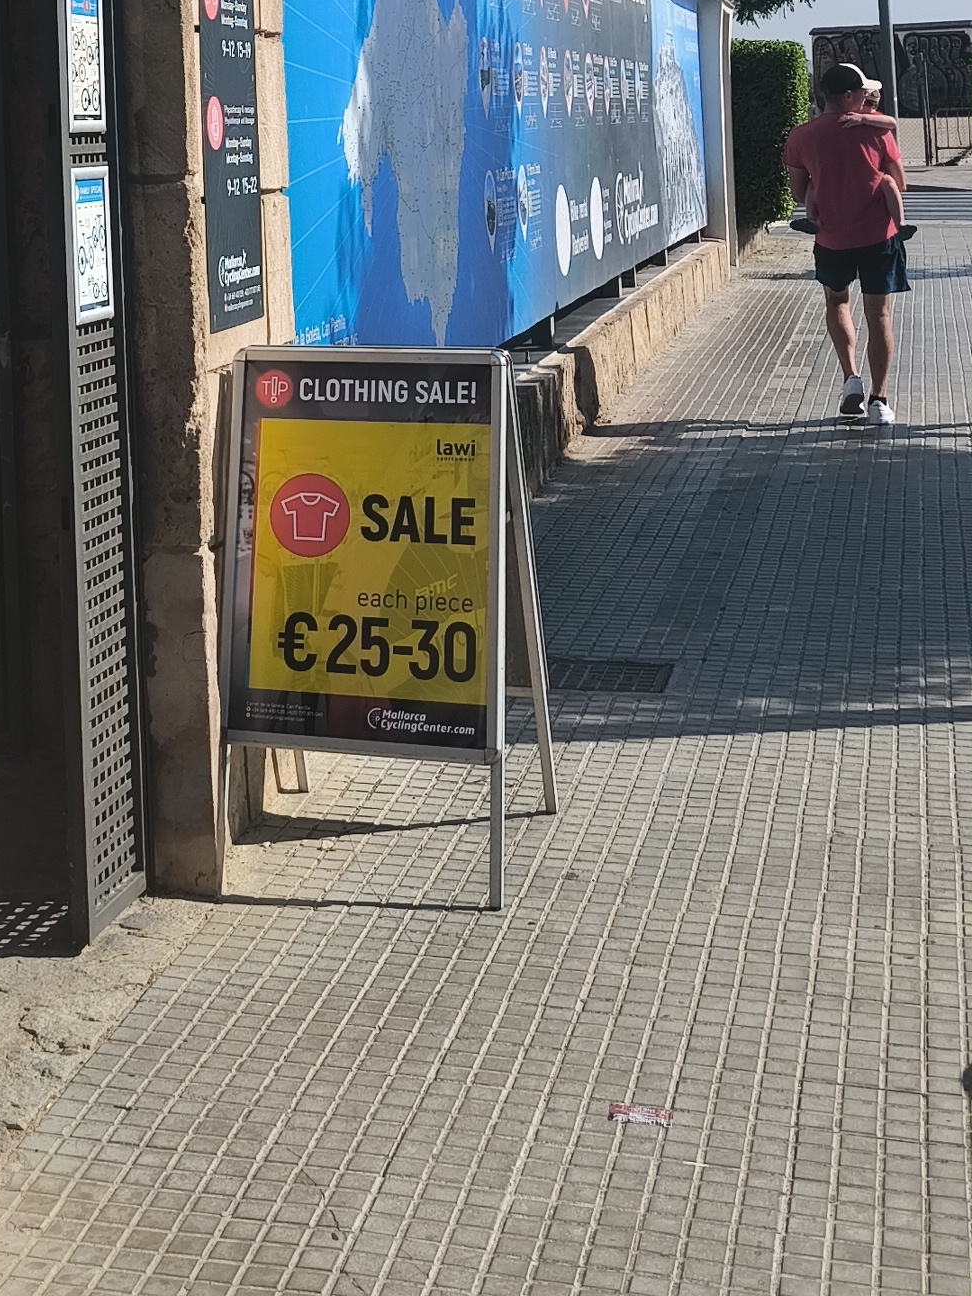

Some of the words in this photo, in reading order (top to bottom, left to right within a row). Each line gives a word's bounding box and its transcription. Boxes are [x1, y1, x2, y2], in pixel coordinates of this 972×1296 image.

[221, 40, 235, 57] 9-12
[236, 41, 251, 59] 15-19
[227, 178, 240, 196] 9-12
[242, 176, 257, 195] 15-22
[321, 320, 330, 338] Can
[299, 378, 409, 403] CLOTHING
[415, 381, 476, 404] SALE!
[437, 439, 475, 457] lawi
[360, 493, 476, 545] SALE
[358, 588, 407, 609] each
[416, 590, 473, 615] piece
[381, 709, 426, 722] Mallorca
[379, 718, 475, 735] CyclingCenter.com
